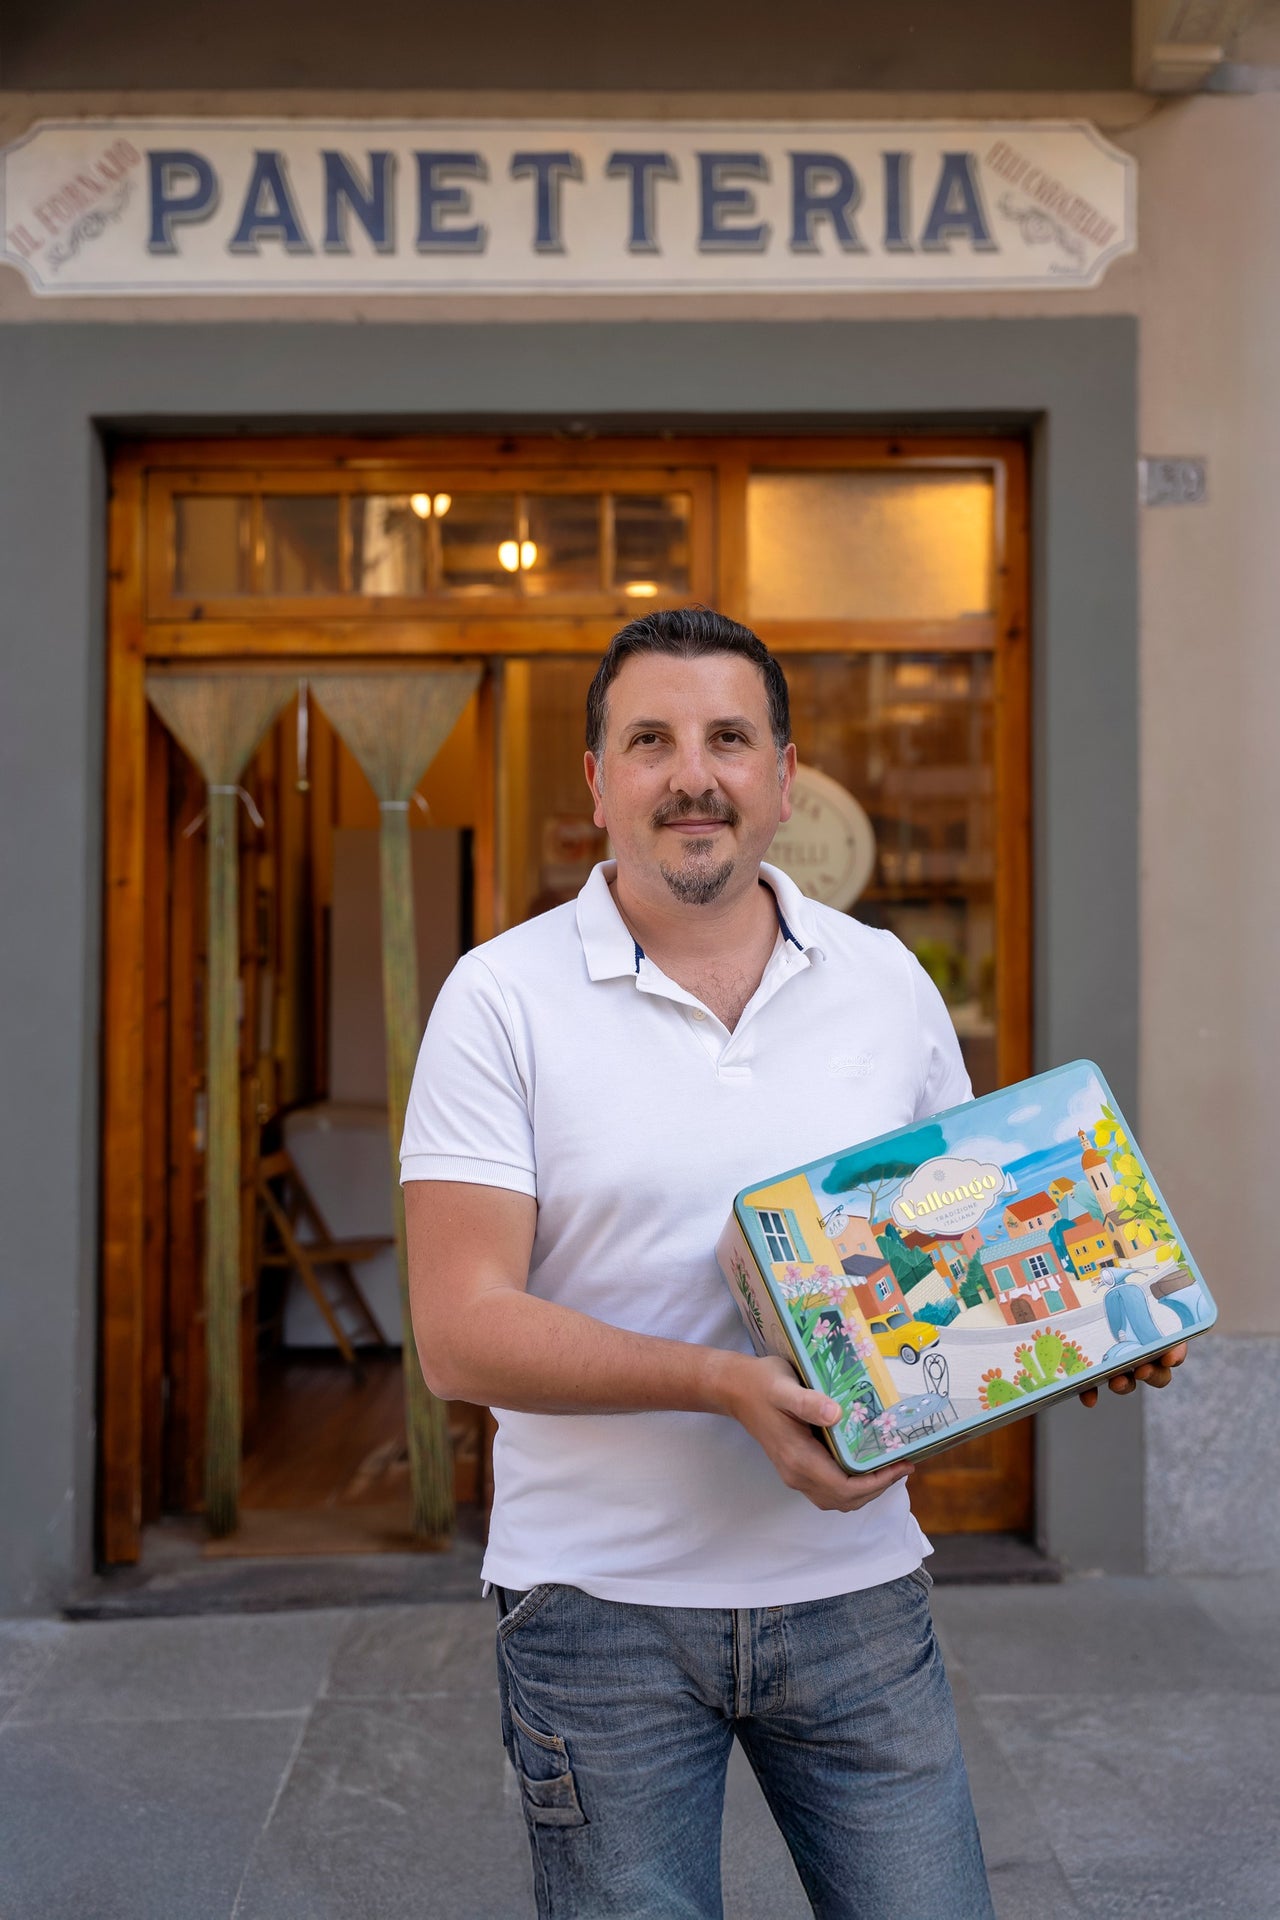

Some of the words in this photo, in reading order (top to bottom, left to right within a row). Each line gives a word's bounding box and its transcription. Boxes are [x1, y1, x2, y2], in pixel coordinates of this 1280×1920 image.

[146, 149, 1001, 257] PANETTERIA
[935, 1202, 978, 1223] TRADIZIONE
[943, 1211, 976, 1227] ITALIANA
